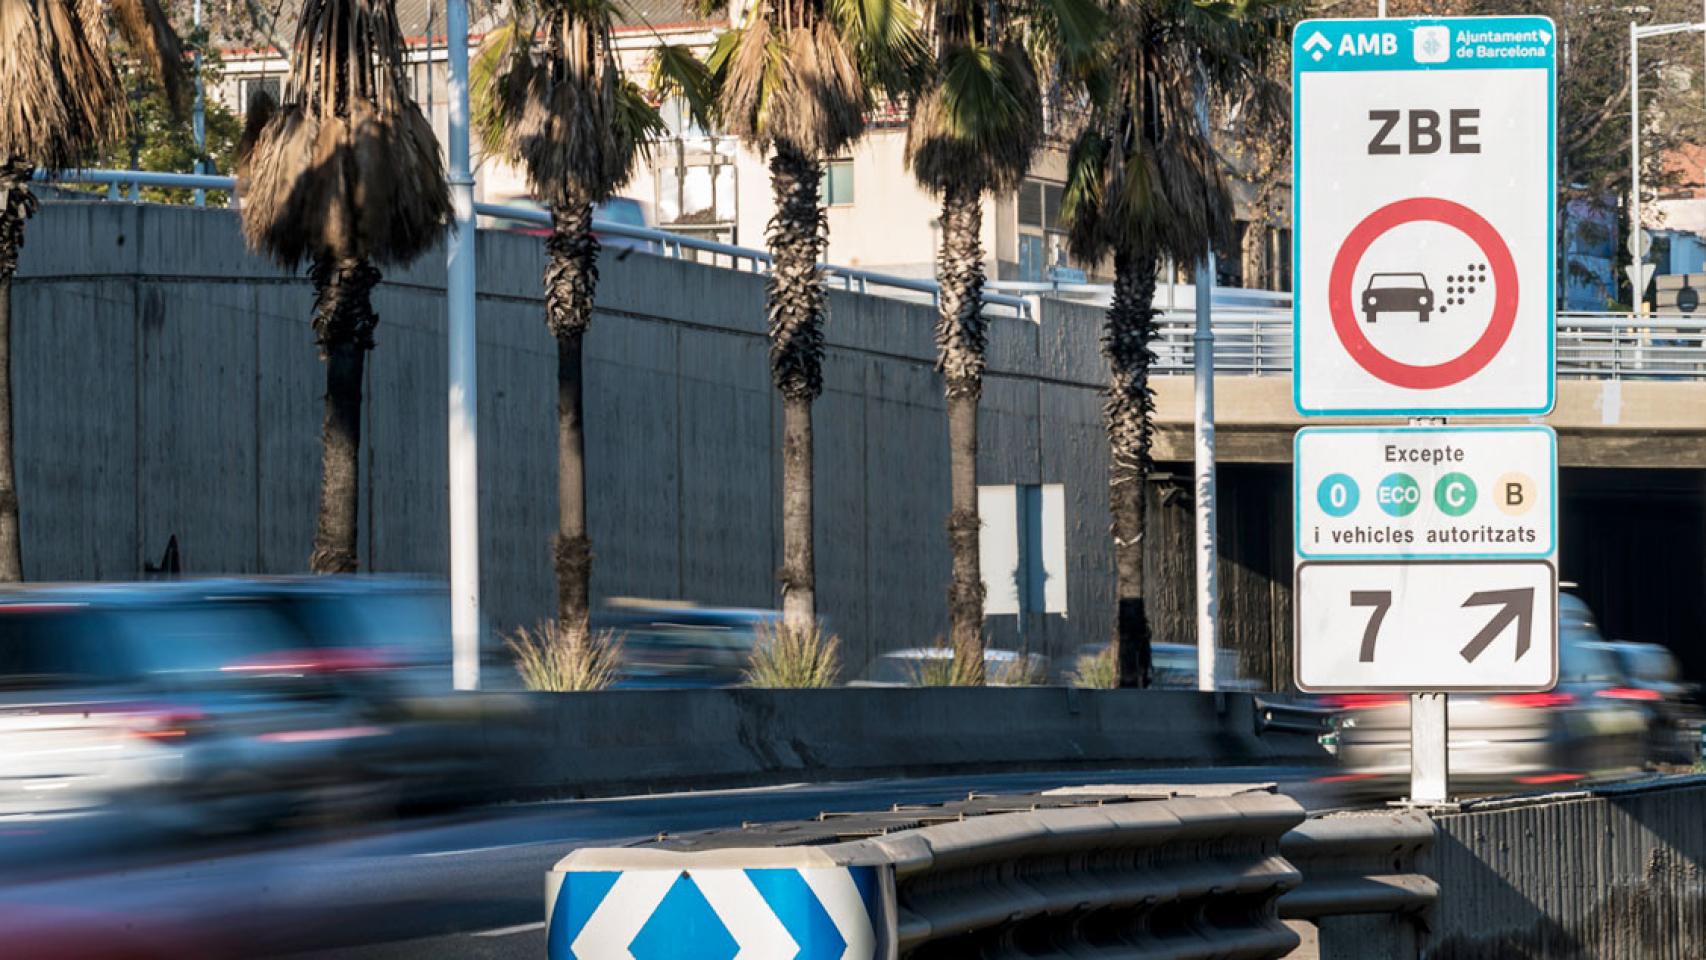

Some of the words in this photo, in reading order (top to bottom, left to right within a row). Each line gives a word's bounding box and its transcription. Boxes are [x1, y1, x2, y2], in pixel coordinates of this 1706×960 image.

[1337, 32, 1398, 57] AMB
[1456, 30, 1539, 46] Ajuntament
[1456, 45, 1474, 58] de
[1476, 45, 1546, 58] Barcelona
[1367, 108, 1482, 155] ZBE
[1384, 445, 1465, 465] Excepte
[1330, 484, 1346, 507] 0
[1379, 486, 1419, 504] ECO
[1446, 483, 1465, 507] C
[1505, 482, 1524, 506] B
[1315, 527, 1320, 543] i
[1332, 526, 1415, 543] vehicles
[1426, 525, 1537, 543] autoritzats
[1350, 590, 1392, 663] 7
